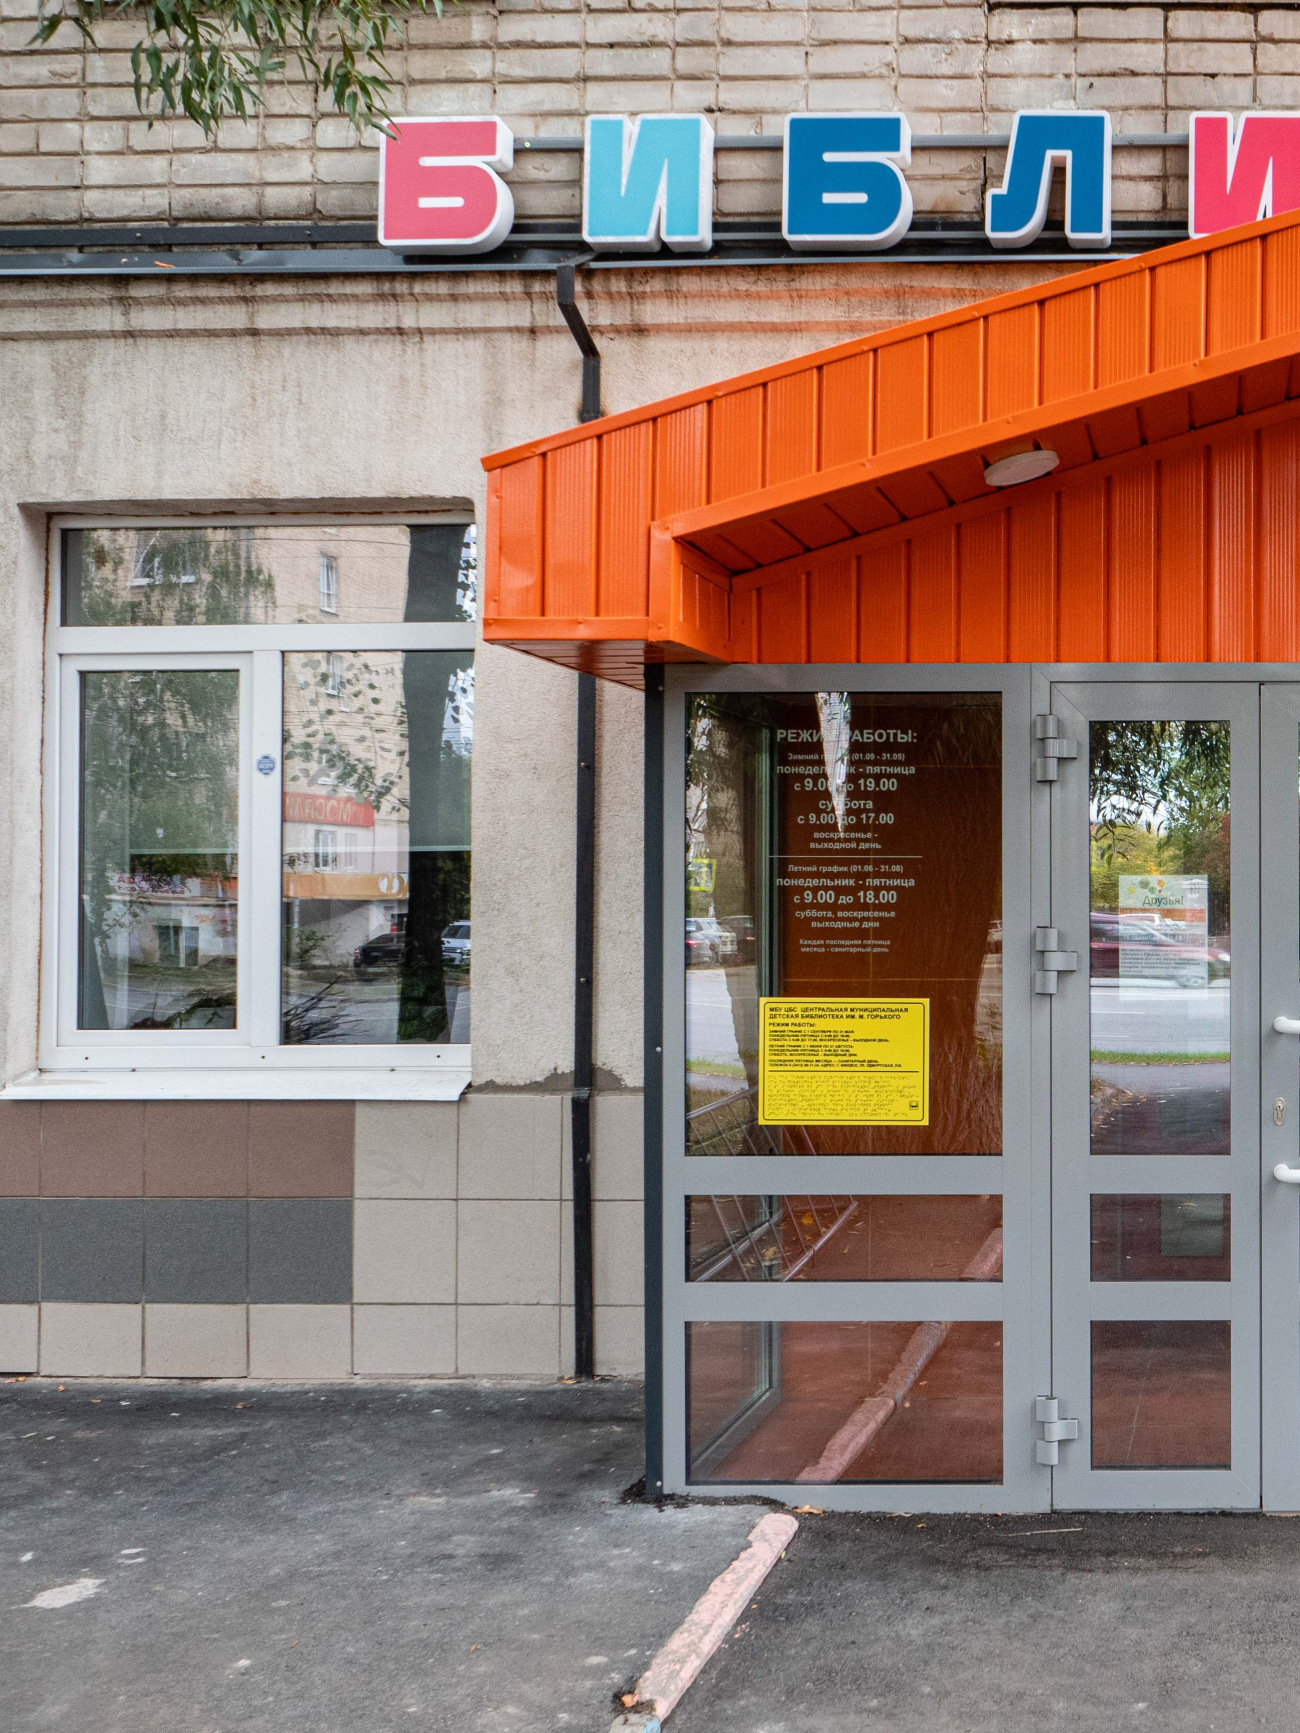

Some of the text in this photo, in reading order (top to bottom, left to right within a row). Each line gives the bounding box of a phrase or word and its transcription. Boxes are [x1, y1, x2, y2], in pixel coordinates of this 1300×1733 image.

[777, 729, 918, 743] РЕЖИ АБОТЫ:
[787, 752, 819, 761] Зимний
[776, 765, 856, 776] понеделк
[866, 765, 916, 777] пятница
[804, 778, 829, 791] 9.0
[857, 778, 898, 791] 19.00
[818, 798, 874, 811] субота
[808, 813, 836, 824] 9.00
[860, 813, 895, 825] 17.00
[813, 831, 873, 841] воскресенье
[809, 840, 882, 851] выходной день
[776, 877, 856, 888] понедельник
[865, 877, 916, 889] пятница
[803, 890, 835, 904] 9.00
[838, 893, 854, 906] до
[857, 890, 898, 904] 18.00
[1142, 895, 1184, 907] Друзья!
[795, 909, 896, 919] суббота, воскресенье
[811, 920, 880, 930] выходные дни
